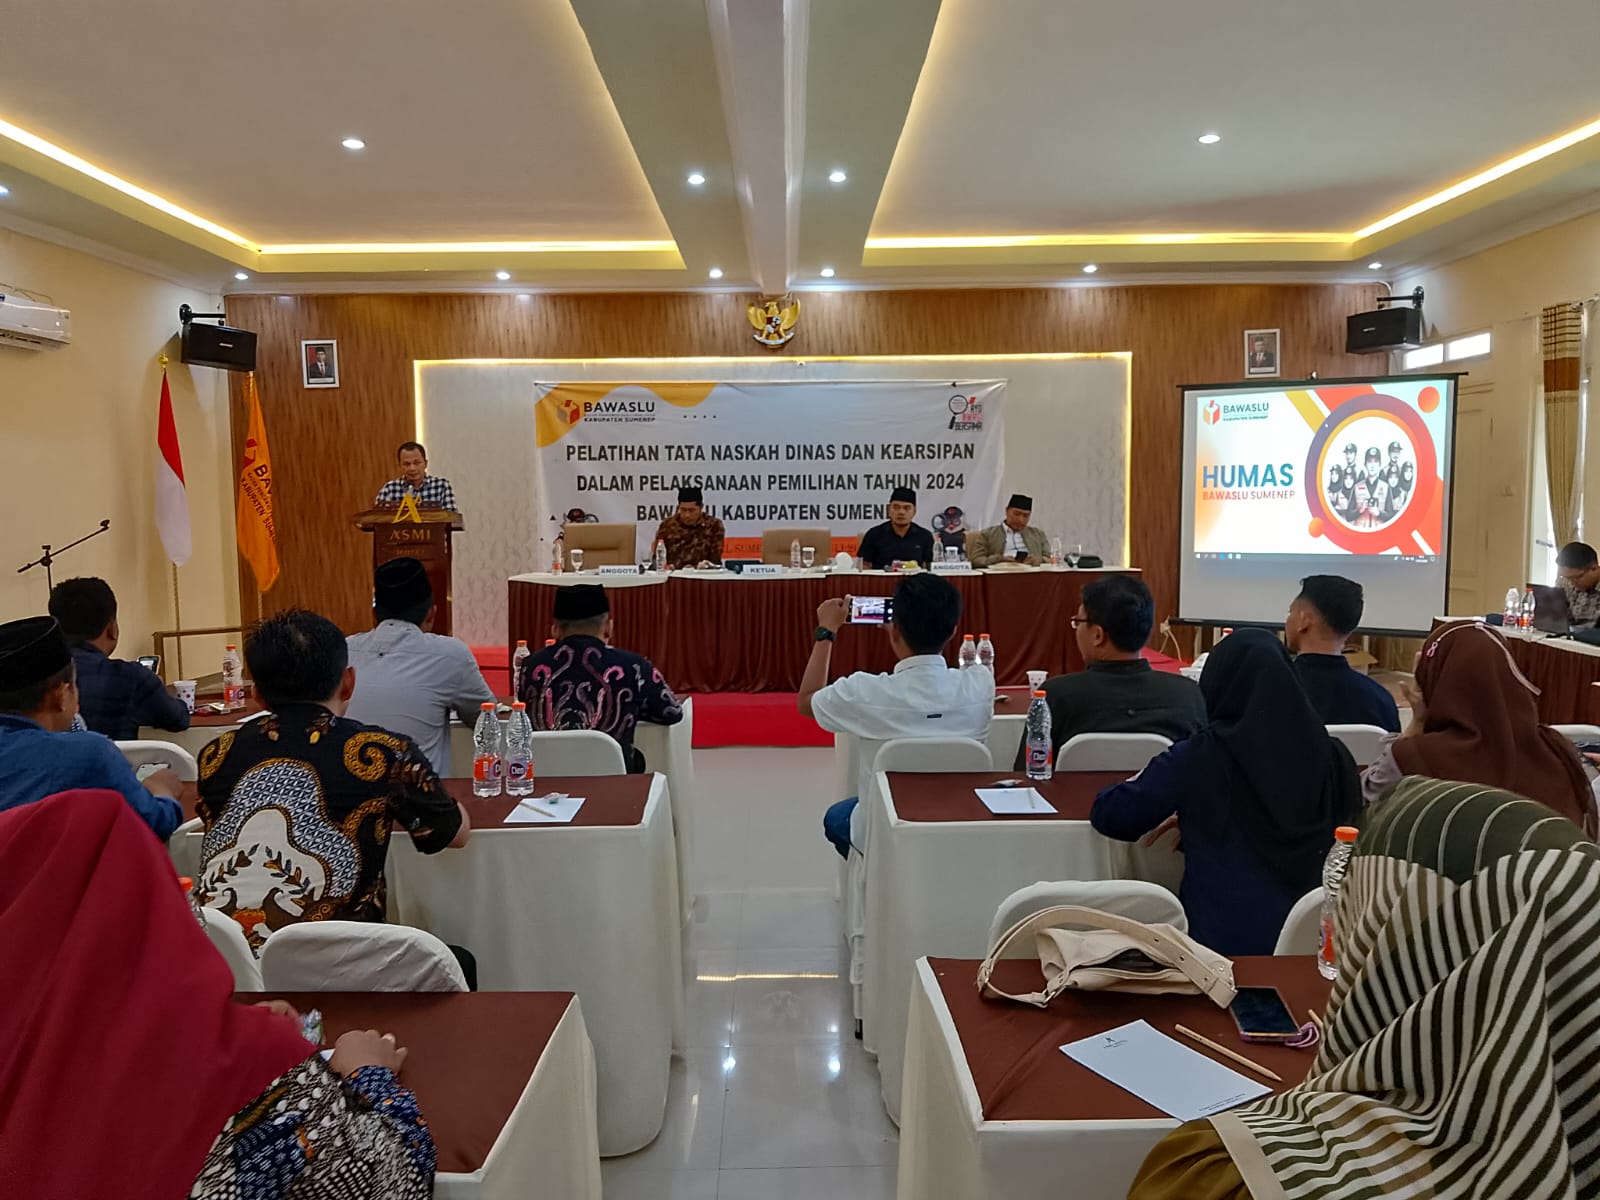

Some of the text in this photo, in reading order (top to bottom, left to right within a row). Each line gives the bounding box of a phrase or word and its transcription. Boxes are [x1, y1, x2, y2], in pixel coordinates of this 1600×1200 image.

[584, 402, 655, 412] BAWASLU
[1223, 403, 1269, 413] BAWASLU
[566, 443, 974, 461] PELATIHAN TATA NASKAH DINAS DAN KEARSIPAN
[577, 473, 965, 491] DALAM PELAKSANAAN PEMILIHAN TAHUN 2024
[1203, 463, 1293, 488] HUMAS
[1203, 491, 1295, 500] BAWASLU SUMENEP
[722, 505, 820, 521] KABUPATEN
[390, 529, 431, 540] ASMI
